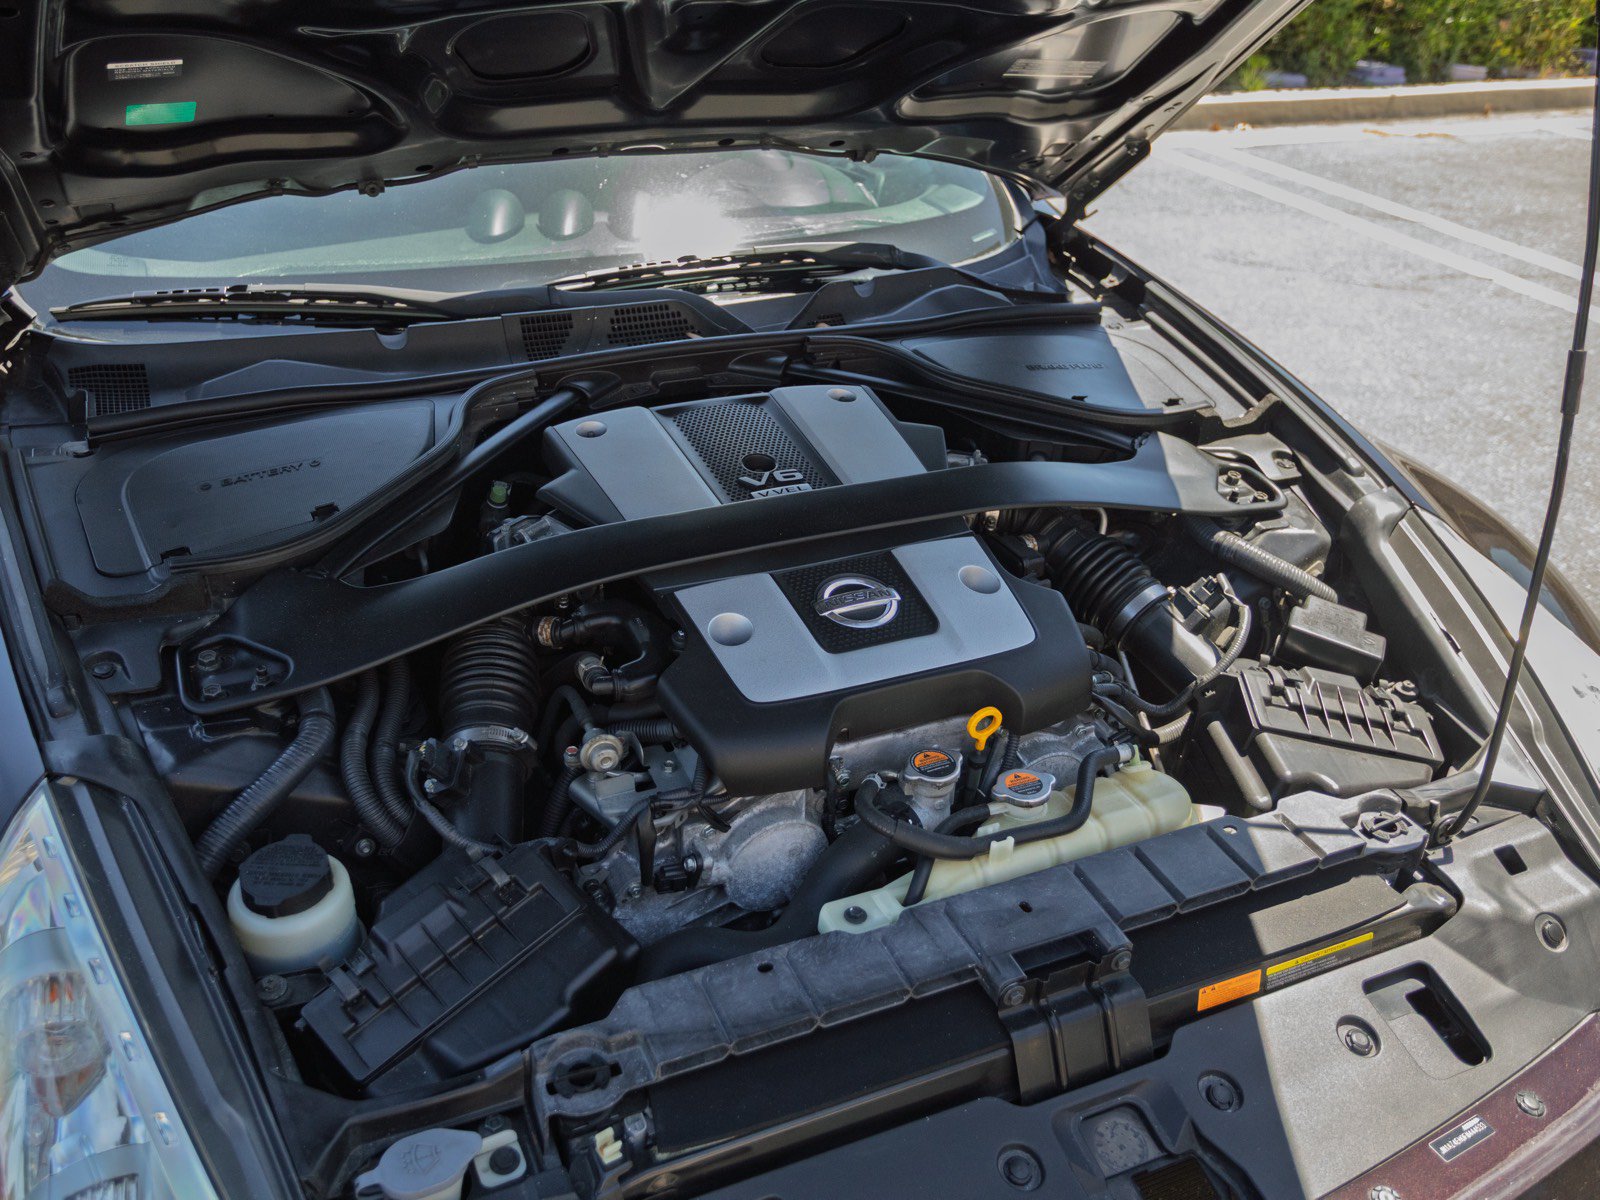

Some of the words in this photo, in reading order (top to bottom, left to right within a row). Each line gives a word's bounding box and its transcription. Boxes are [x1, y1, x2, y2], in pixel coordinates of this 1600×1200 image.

[221, 462, 303, 487] BATTERY
[738, 468, 804, 486] V6
[757, 485, 808, 497] VVEL
[824, 588, 891, 609] NISSAN
